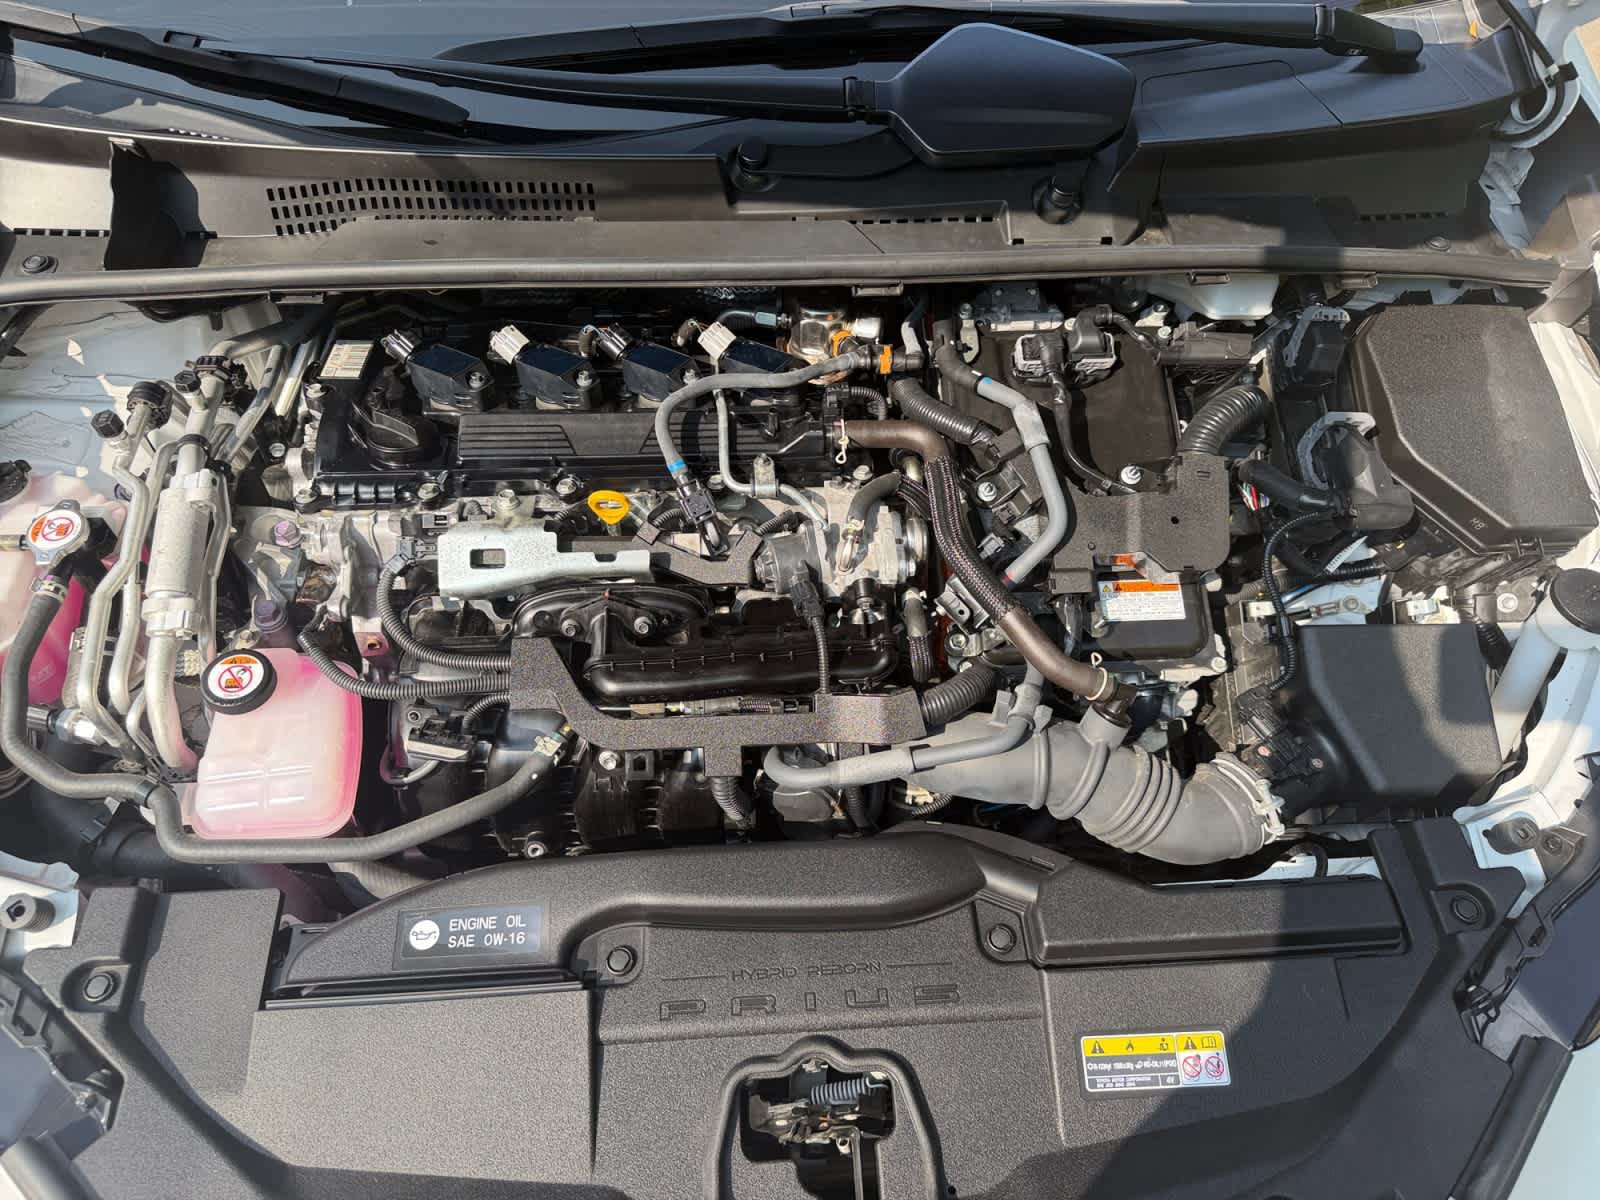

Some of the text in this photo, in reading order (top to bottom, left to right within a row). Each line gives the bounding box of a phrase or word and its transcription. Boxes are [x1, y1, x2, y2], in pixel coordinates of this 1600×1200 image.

[449, 914, 527, 932] ENGINE OIL
[448, 932, 526, 948] SAE 0W-16
[732, 961, 882, 982] HYBRID REBORN
[659, 984, 961, 1020] PRIUS
